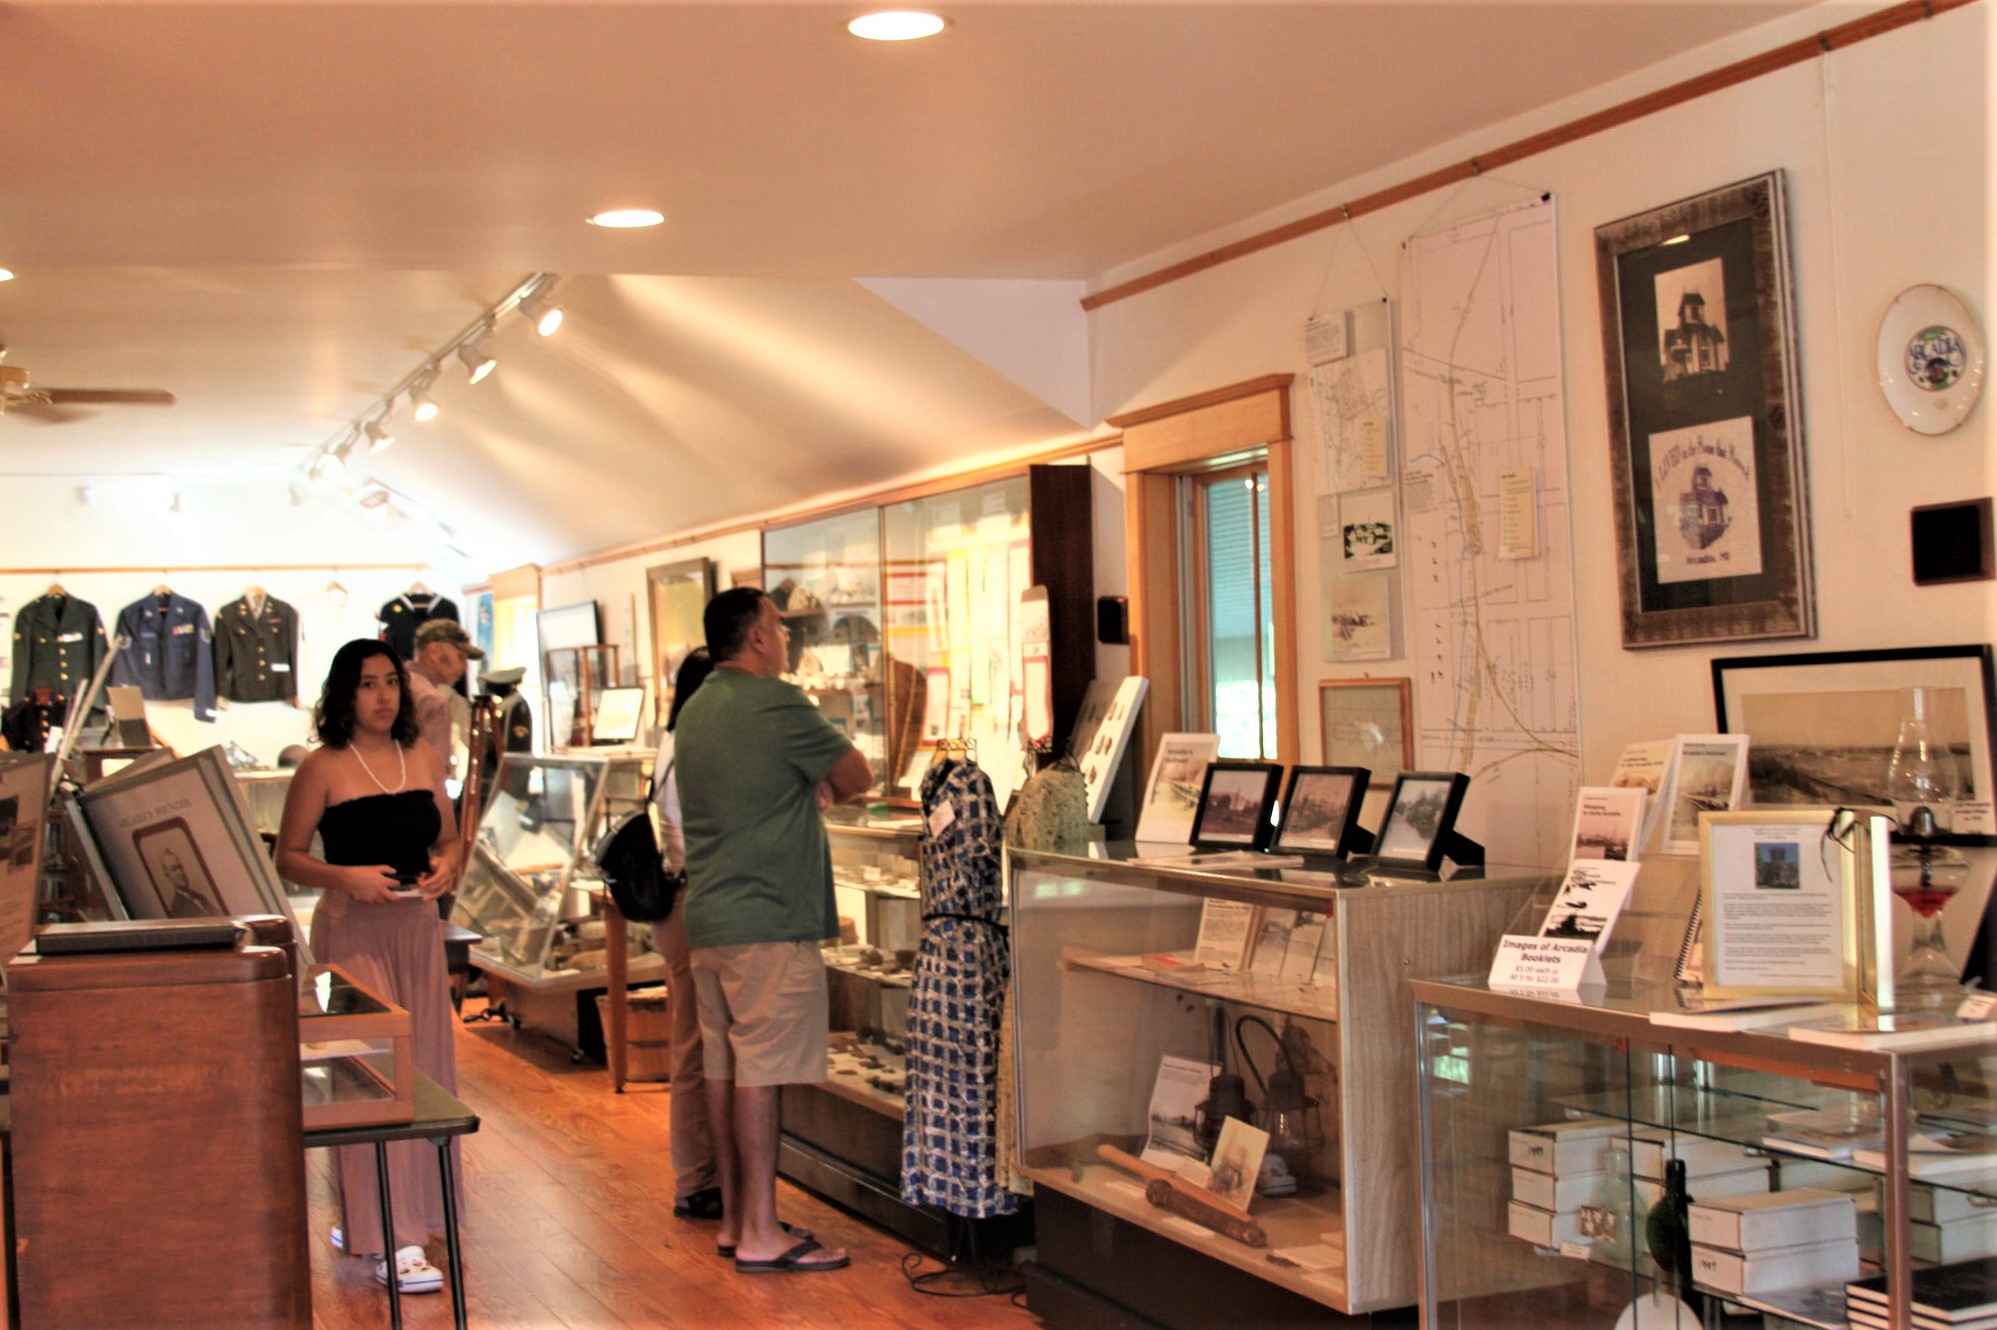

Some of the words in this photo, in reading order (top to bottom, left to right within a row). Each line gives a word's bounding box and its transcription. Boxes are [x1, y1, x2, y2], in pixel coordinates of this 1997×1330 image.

[1503, 940, 1537, 951] Images
[1553, 943, 1588, 954] Arcadia
[1521, 953, 1561, 963] Booklets
